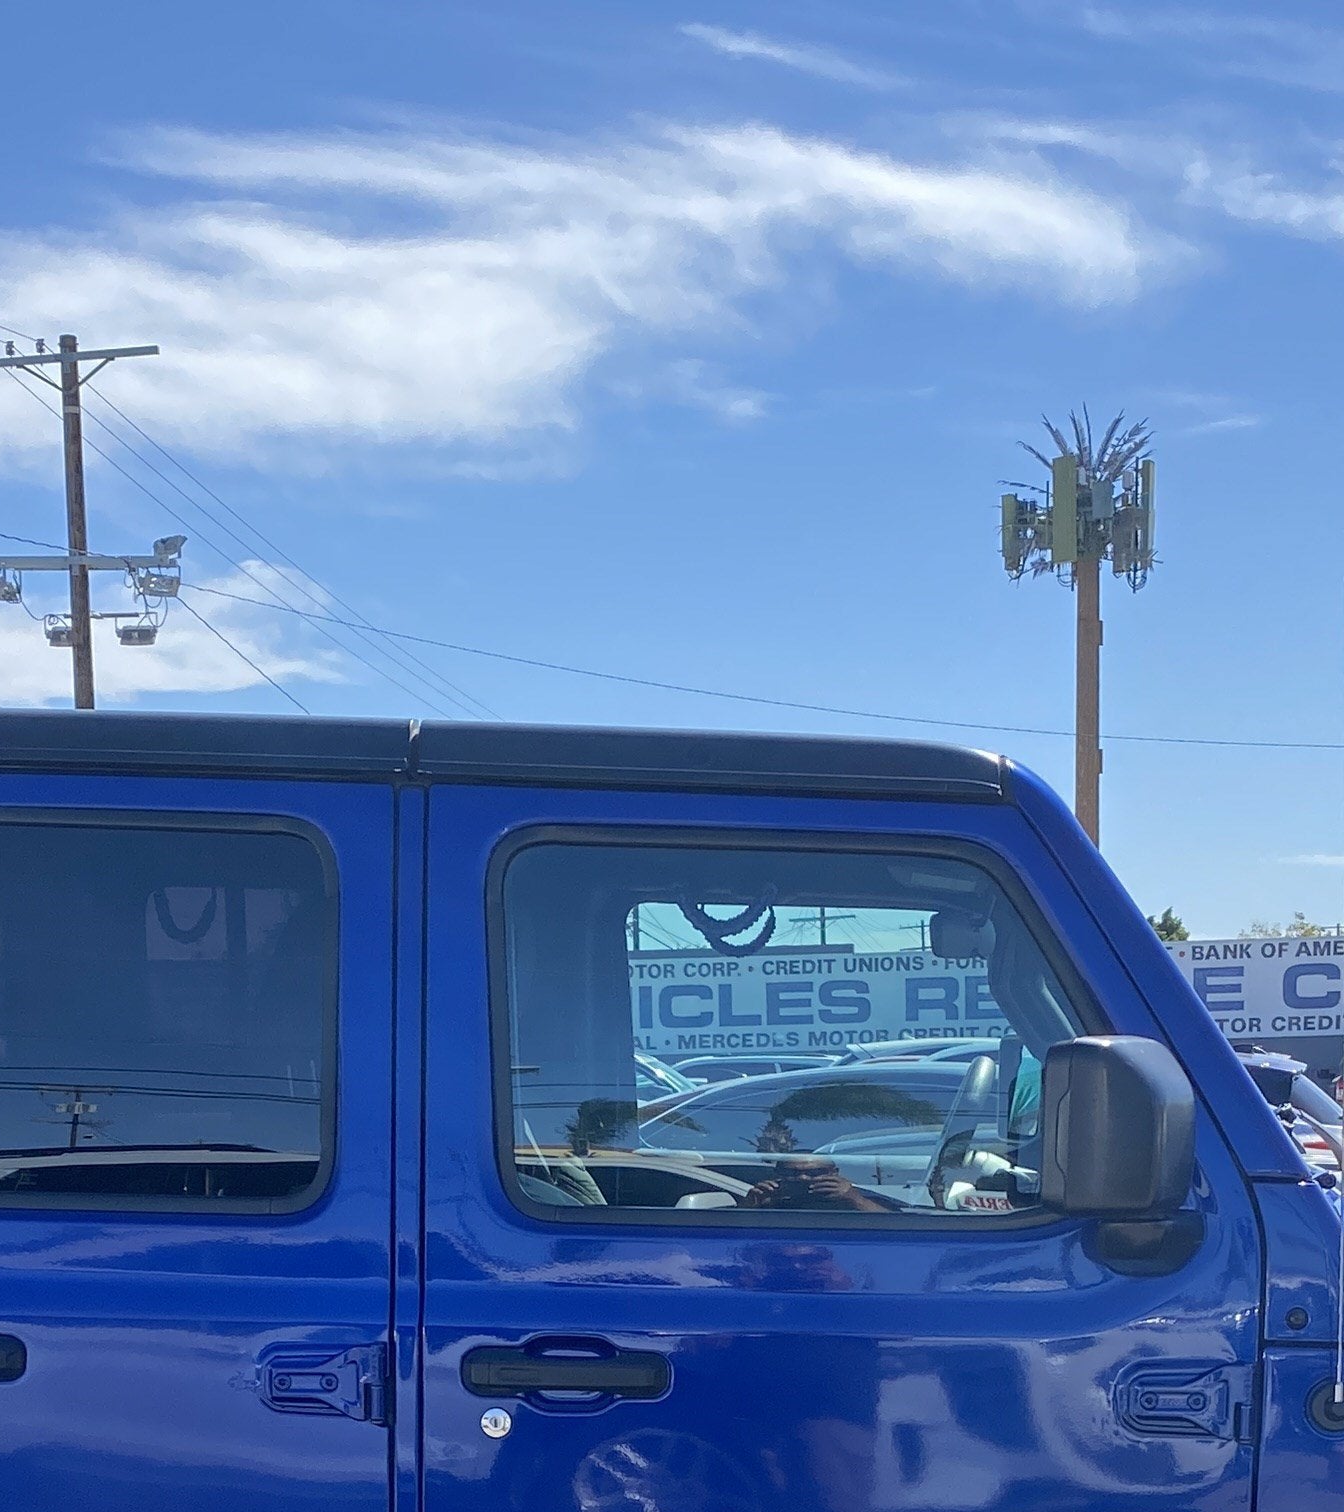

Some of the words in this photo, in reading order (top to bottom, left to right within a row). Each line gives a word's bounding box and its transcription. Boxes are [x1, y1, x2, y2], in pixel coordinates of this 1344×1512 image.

[683, 961, 742, 978] CORP.
[762, 958, 836, 976] CREDIT
[843, 955, 925, 973] UNIONS
[1191, 943, 1252, 961] BANK
[1260, 941, 1289, 959] OF
[630, 979, 871, 1029] ICLES
[808, 1029, 889, 1047] MOTOR
